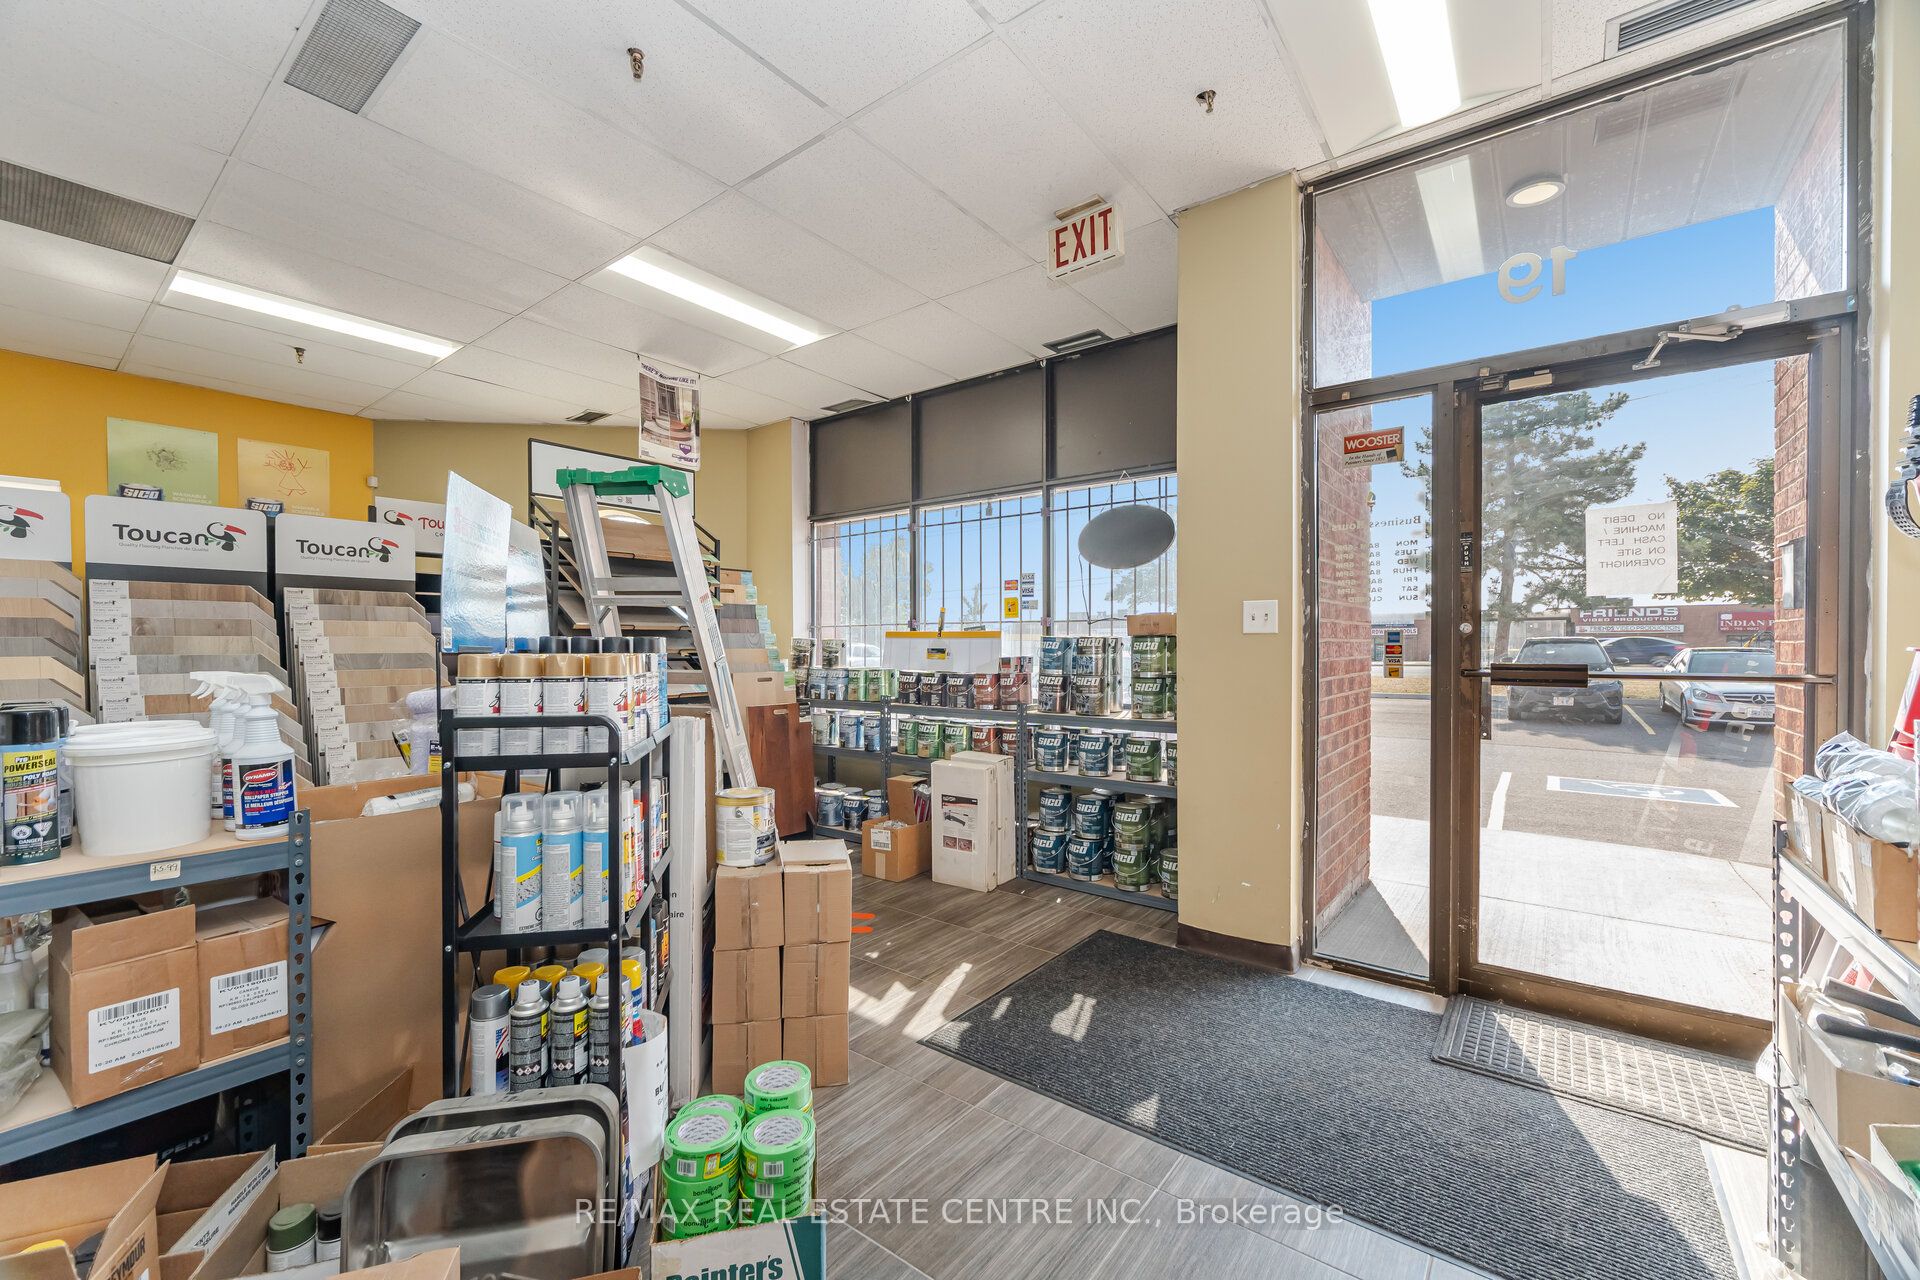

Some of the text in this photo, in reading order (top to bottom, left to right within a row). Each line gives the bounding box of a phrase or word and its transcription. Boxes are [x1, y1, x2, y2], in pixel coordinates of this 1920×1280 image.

[1055, 207, 1112, 268] EXIT
[1346, 433, 1400, 450] WOOSTER
[123, 488, 159, 500] SICO
[251, 502, 281, 512] SICO
[418, 517, 444, 530] Tou
[112, 523, 209, 546] Toucan
[296, 539, 370, 558] Toucan
[1078, 638, 1104, 646] SICO
[1133, 642, 1159, 651] SICO
[1039, 676, 1063, 684] SICO
[1076, 677, 1100, 685] SICO
[1134, 683, 1161, 692] SICO
[945, 726, 964, 735] SICO
[1038, 737, 1061, 747] SICO
[1080, 740, 1103, 750] SICO
[1126, 744, 1149, 754] SICO
[15, 754, 43, 763] ProLine
[4, 757, 56, 774] POWERSEAL
[23, 772, 41, 781] POLY
[245, 771, 276, 781] DYNAMIC
[1040, 797, 1062, 807] SICO
[1077, 803, 1100, 813] SICO
[1115, 811, 1140, 822] SICO
[1033, 837, 1054, 848] SICO
[1069, 843, 1088, 854] SICO
[1114, 853, 1135, 864] SICO
[1163, 860, 1177, 870] SIC
[250, 998, 267, 1006] BLACK
[127, 1024, 151, 1035] CALIPER
[152, 1020, 169, 1028] PAINT
[104, 1028, 164, 1048] CHROME ALUMINUM
